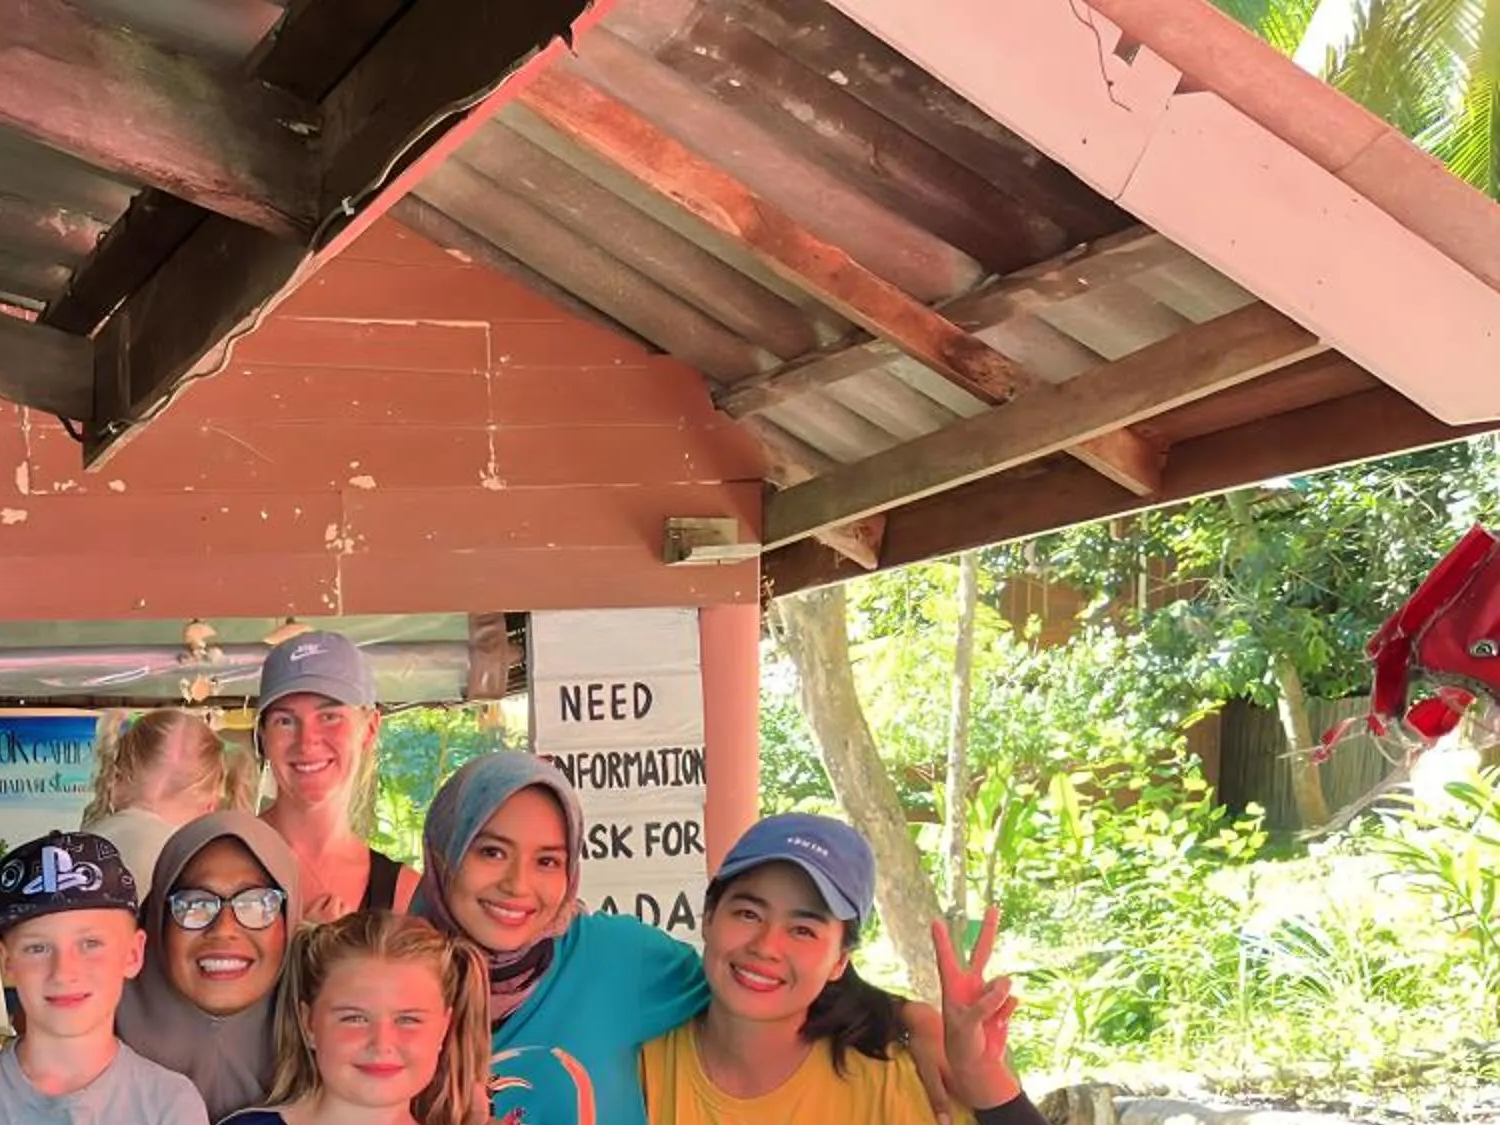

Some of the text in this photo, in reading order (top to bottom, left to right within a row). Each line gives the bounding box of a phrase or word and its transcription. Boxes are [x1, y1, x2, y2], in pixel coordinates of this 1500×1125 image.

[560, 682, 653, 722] NEED
[546, 747, 707, 789] NFORMATION
[644, 820, 705, 857] FOR
